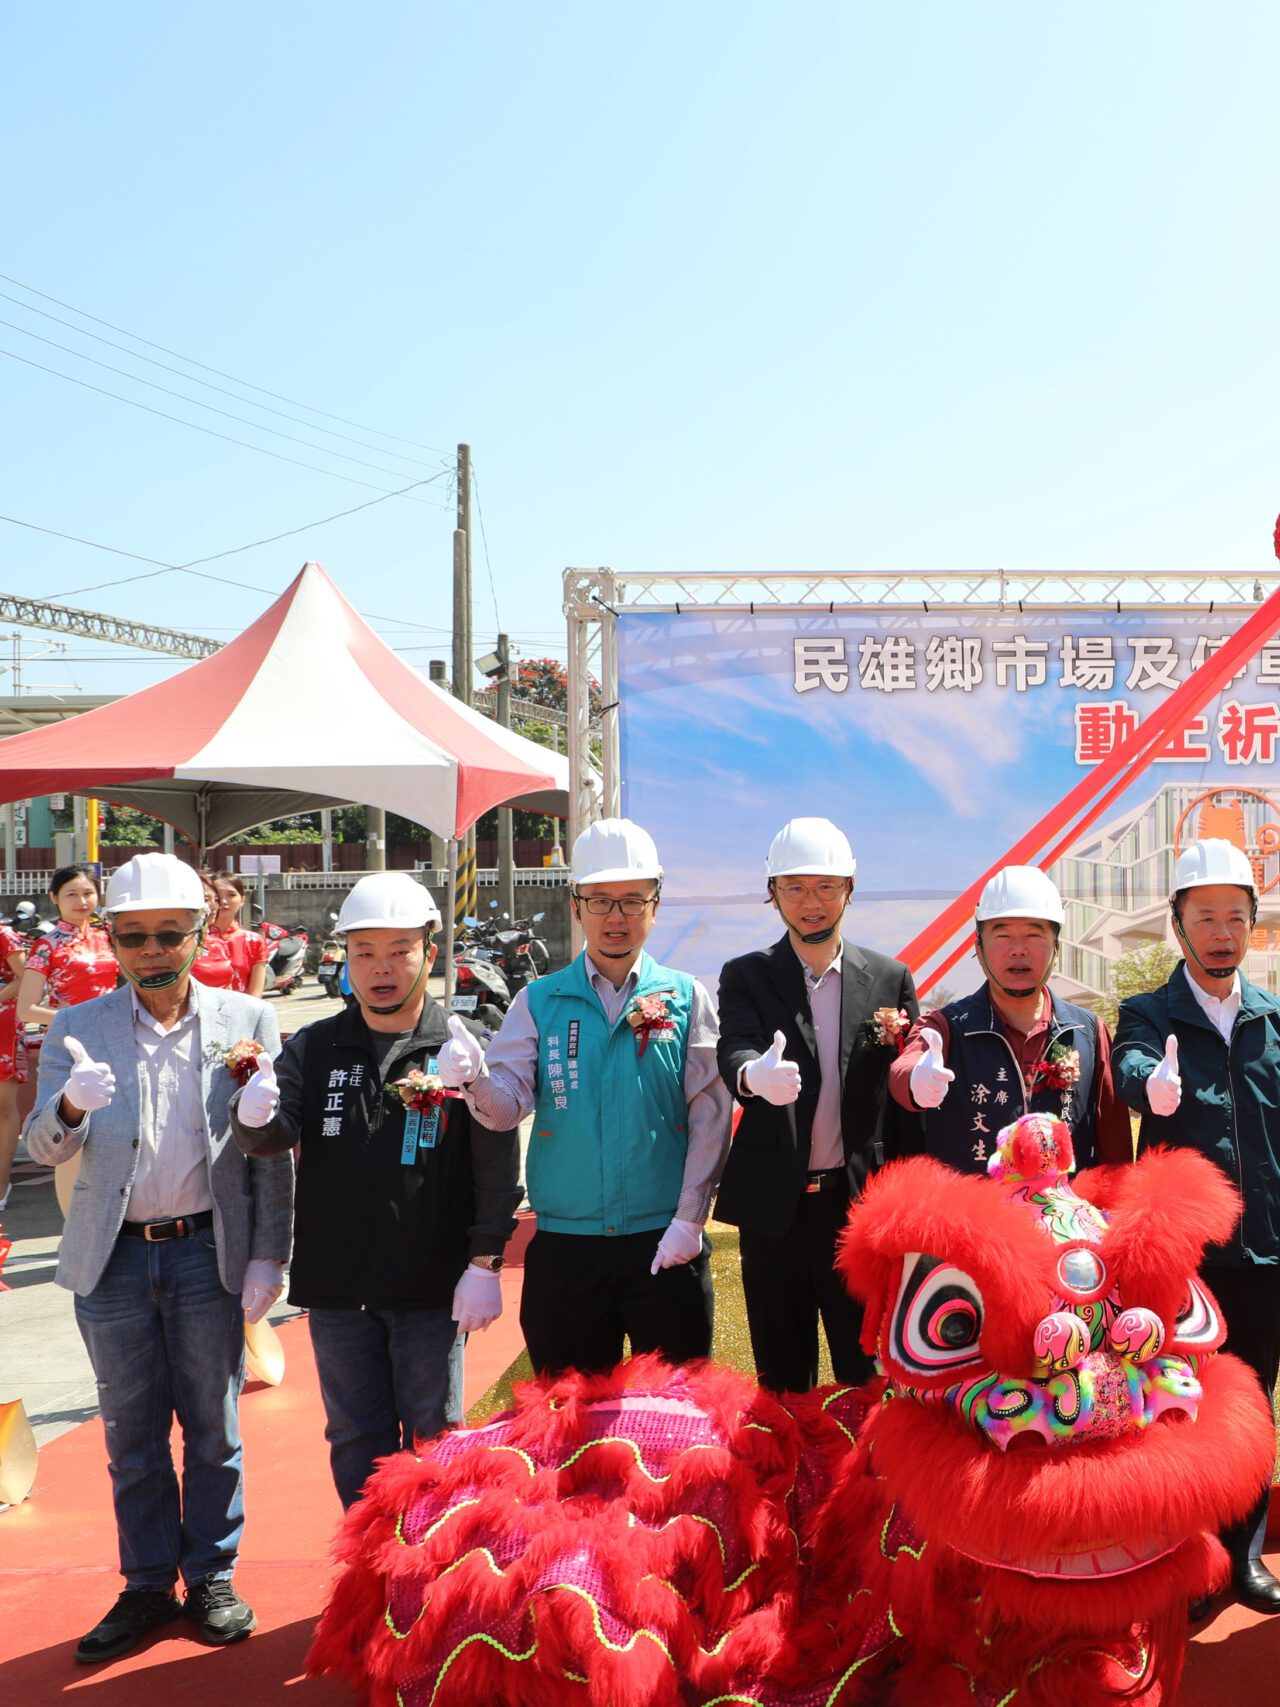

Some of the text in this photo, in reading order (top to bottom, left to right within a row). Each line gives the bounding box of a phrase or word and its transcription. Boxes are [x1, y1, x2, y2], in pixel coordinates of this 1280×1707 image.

[349, 1064, 364, 1087] 主任
[994, 1067, 1009, 1106] 主席
[322, 1069, 348, 1137] 許正憲
[970, 1083, 991, 1161] 涂文生
